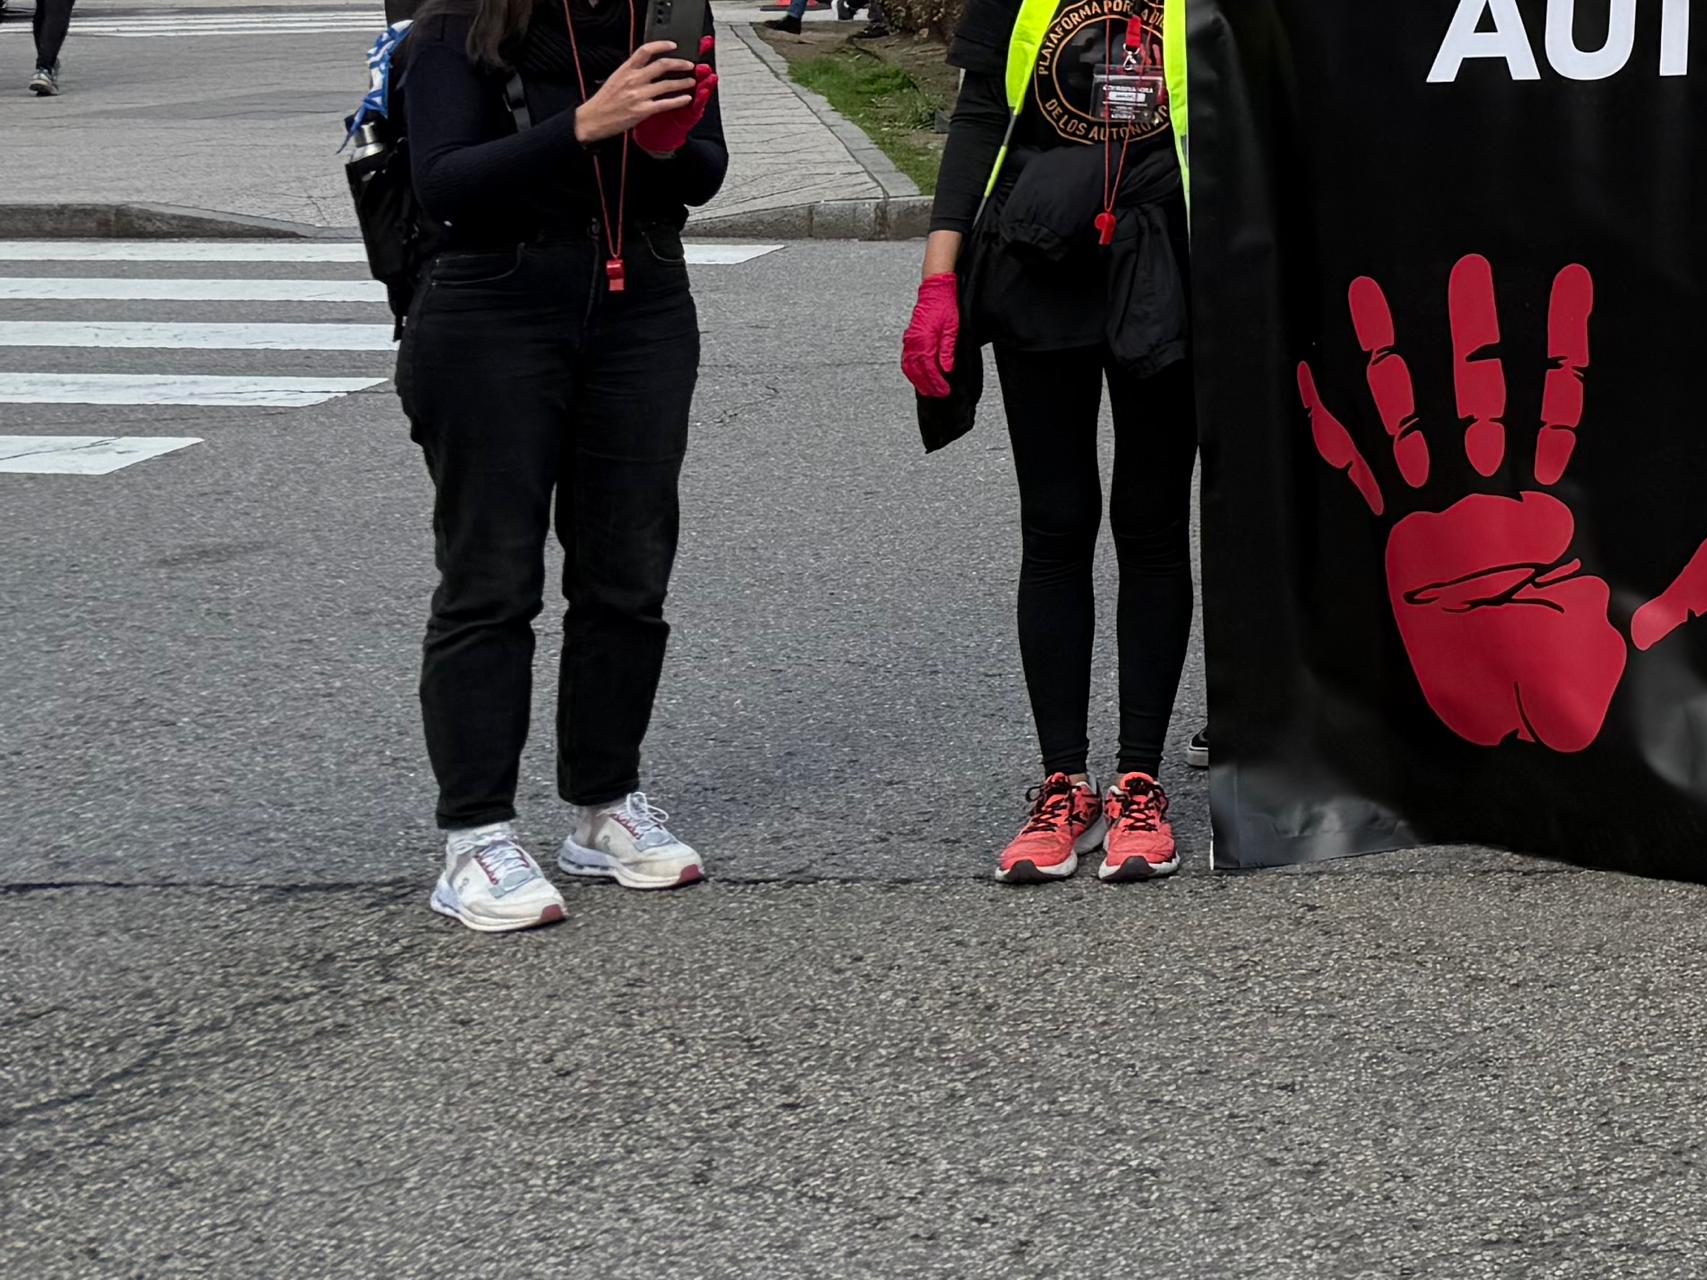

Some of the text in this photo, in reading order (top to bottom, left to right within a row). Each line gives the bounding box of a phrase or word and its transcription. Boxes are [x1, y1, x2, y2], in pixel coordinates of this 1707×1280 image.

[1038, 2, 1101, 75] PLATAFORMA
[1045, 98, 1088, 136] DE LOS
